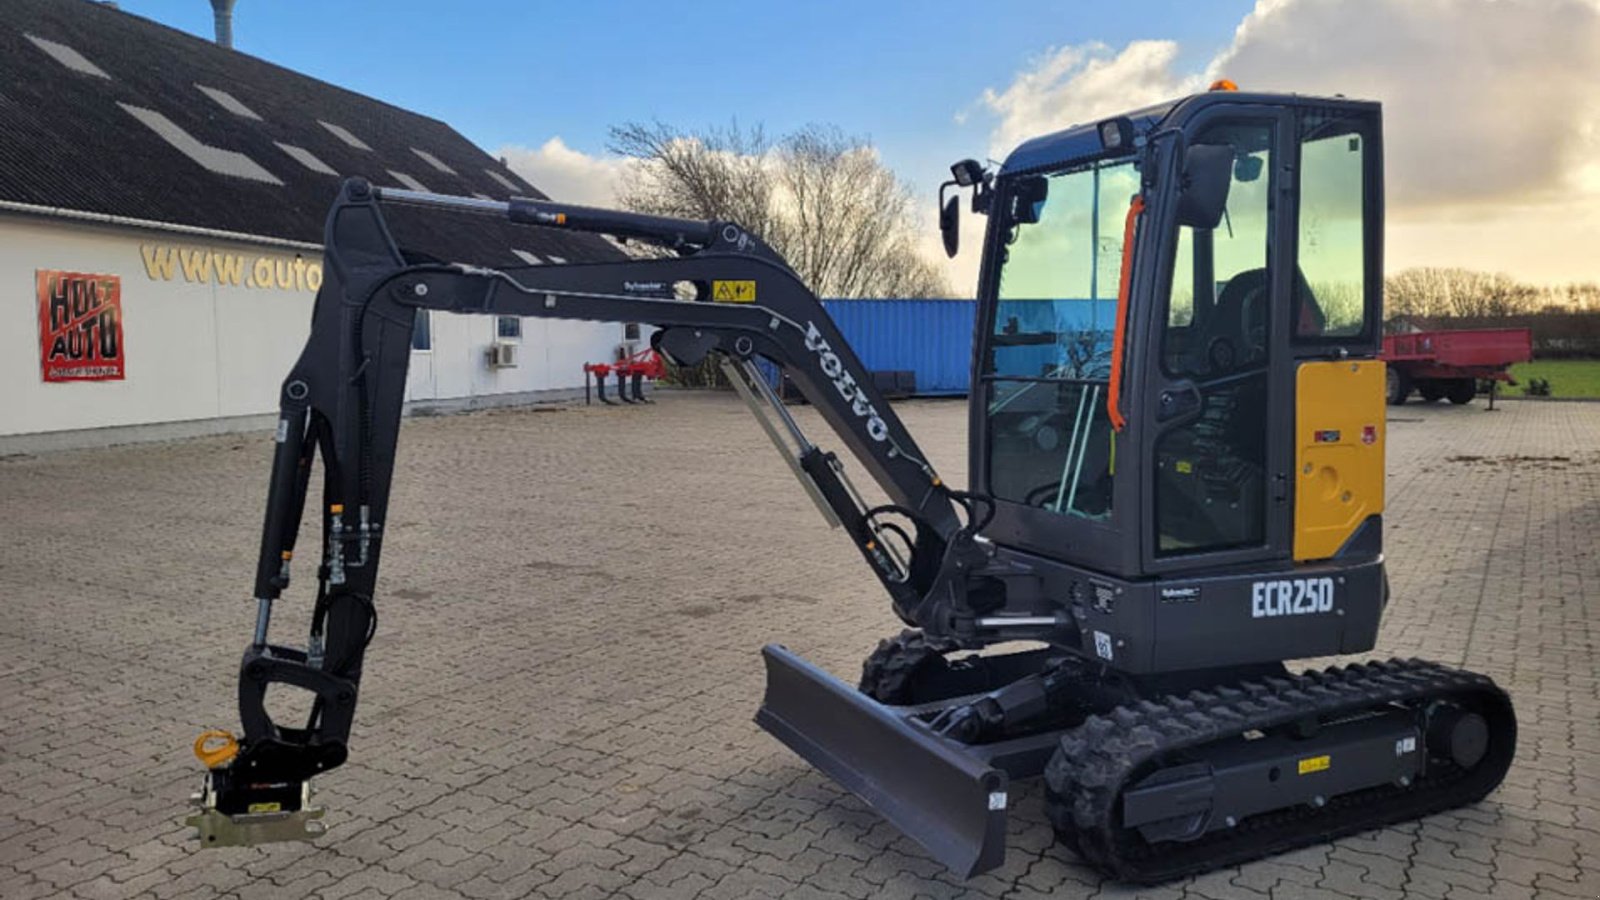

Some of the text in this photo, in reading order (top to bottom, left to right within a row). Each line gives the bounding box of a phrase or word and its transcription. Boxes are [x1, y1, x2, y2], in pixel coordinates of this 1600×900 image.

[48, 277, 114, 333] HOLT
[48, 305, 118, 361] AUTO
[804, 320, 889, 441] VOLVO
[1252, 577, 1335, 617] ECR25D
